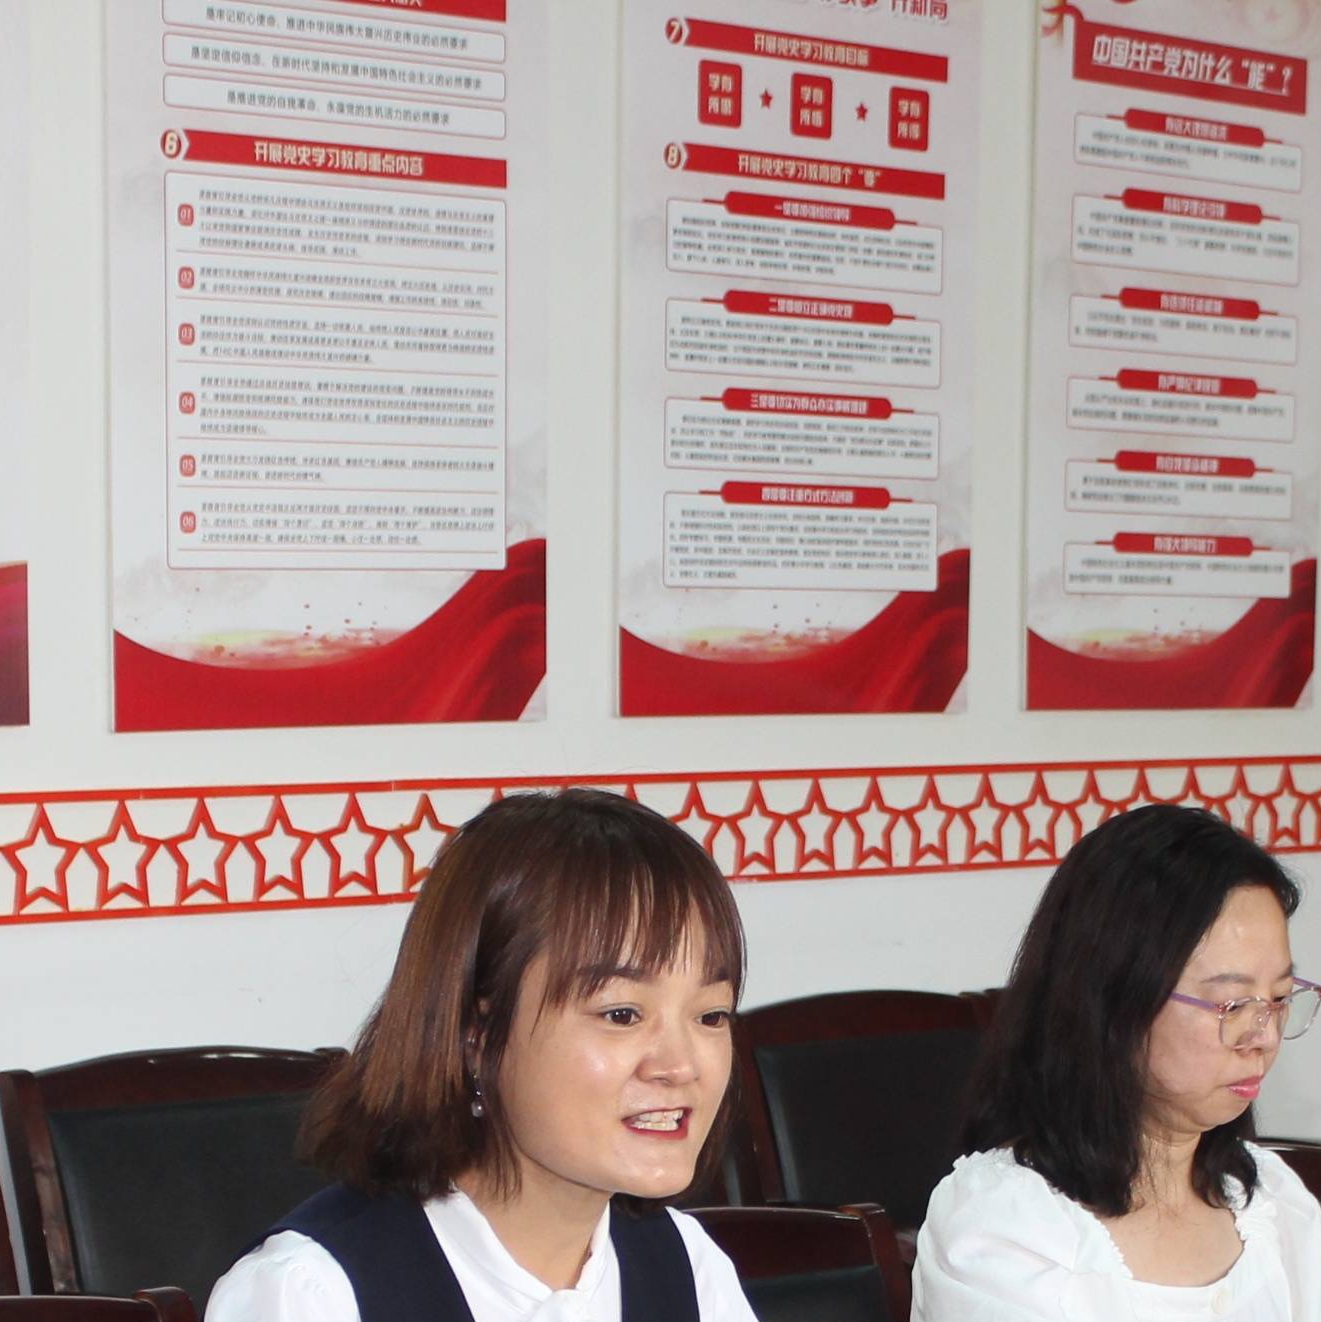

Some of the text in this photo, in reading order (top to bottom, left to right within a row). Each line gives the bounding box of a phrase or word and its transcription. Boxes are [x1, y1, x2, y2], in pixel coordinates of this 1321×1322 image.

[254, 141, 423, 176] 开展党史学习教育重点内容
